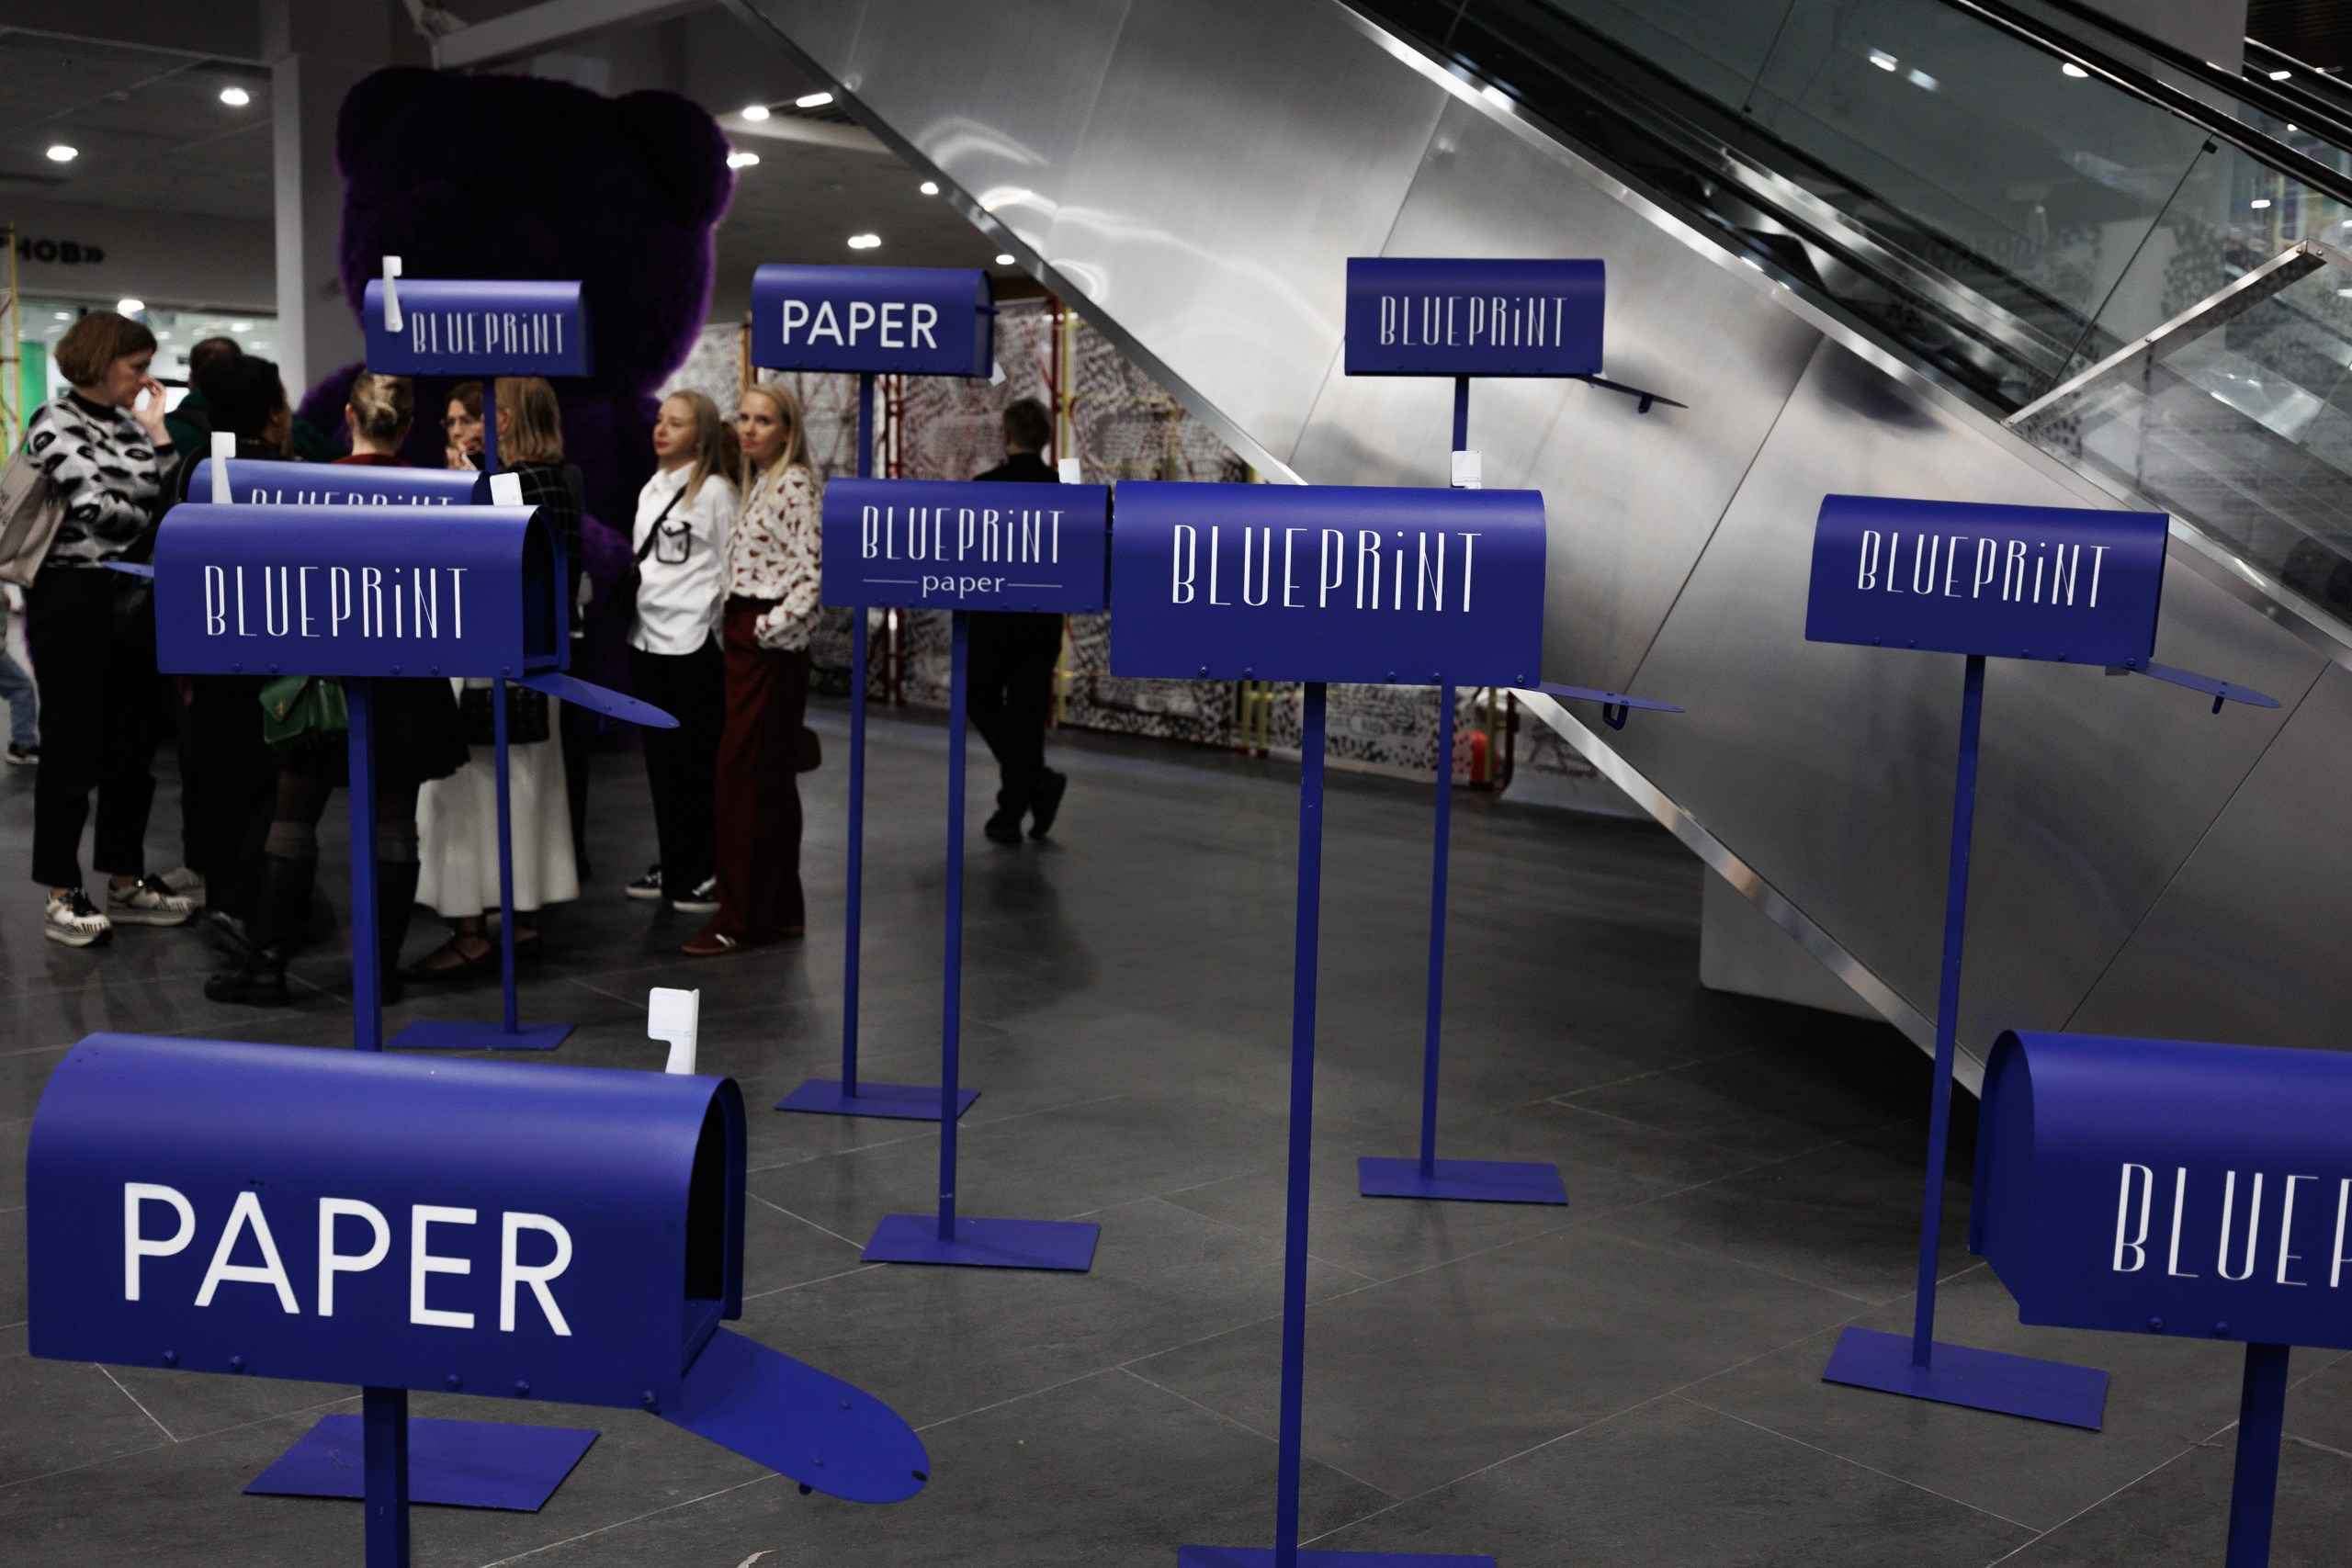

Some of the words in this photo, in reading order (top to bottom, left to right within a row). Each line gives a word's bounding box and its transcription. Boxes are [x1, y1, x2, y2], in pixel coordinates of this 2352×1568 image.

[781, 298, 939, 350] PAPER
[922, 574, 1006, 600] paper
[123, 1181, 574, 1337] PAPER
